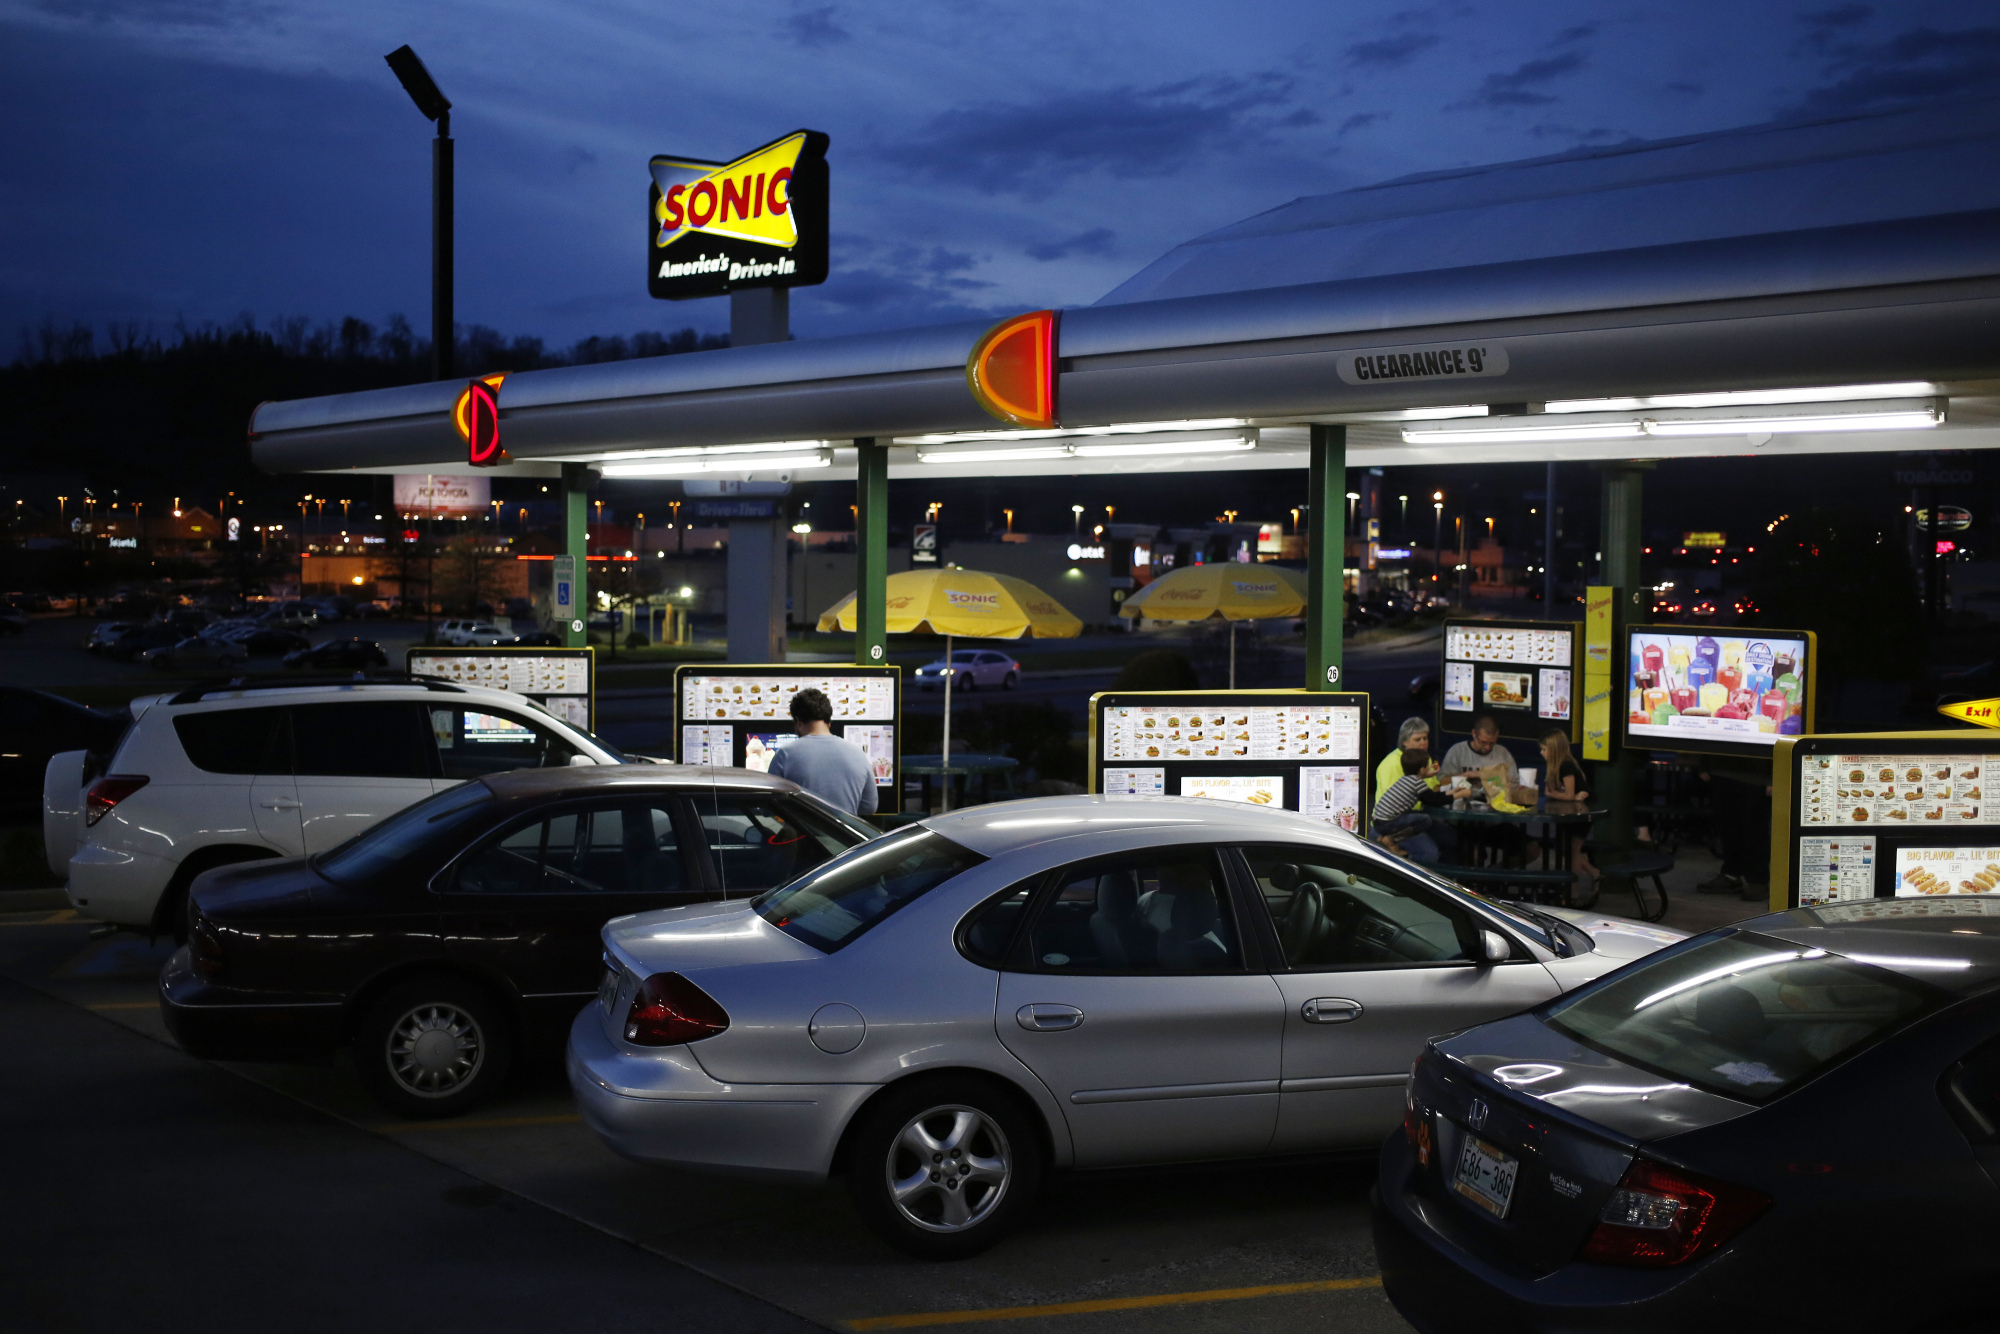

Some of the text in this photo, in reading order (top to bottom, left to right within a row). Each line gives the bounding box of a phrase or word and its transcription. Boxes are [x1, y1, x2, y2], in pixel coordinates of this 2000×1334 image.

[663, 167, 792, 231] SONIC
[658, 253, 729, 278] America's
[1354, 347, 1487, 381] CLEARANCE 9'
[1894, 470, 1973, 483] TOBACCO
[436, 486, 469, 498] TOYOTA
[1237, 584, 1277, 592] SONIC
[950, 592, 997, 604] SONIC
[872, 648, 881, 657] 27
[1328, 669, 1337, 680] 26
[1965, 706, 1992, 717] Exit
[1841, 755, 1860, 763] COMBOS
[1256, 779, 1272, 787] BITE
[1907, 851, 1921, 861] BIG
[1923, 850, 1955, 861] FLAVOR
[1970, 850, 1985, 861] LIL'
